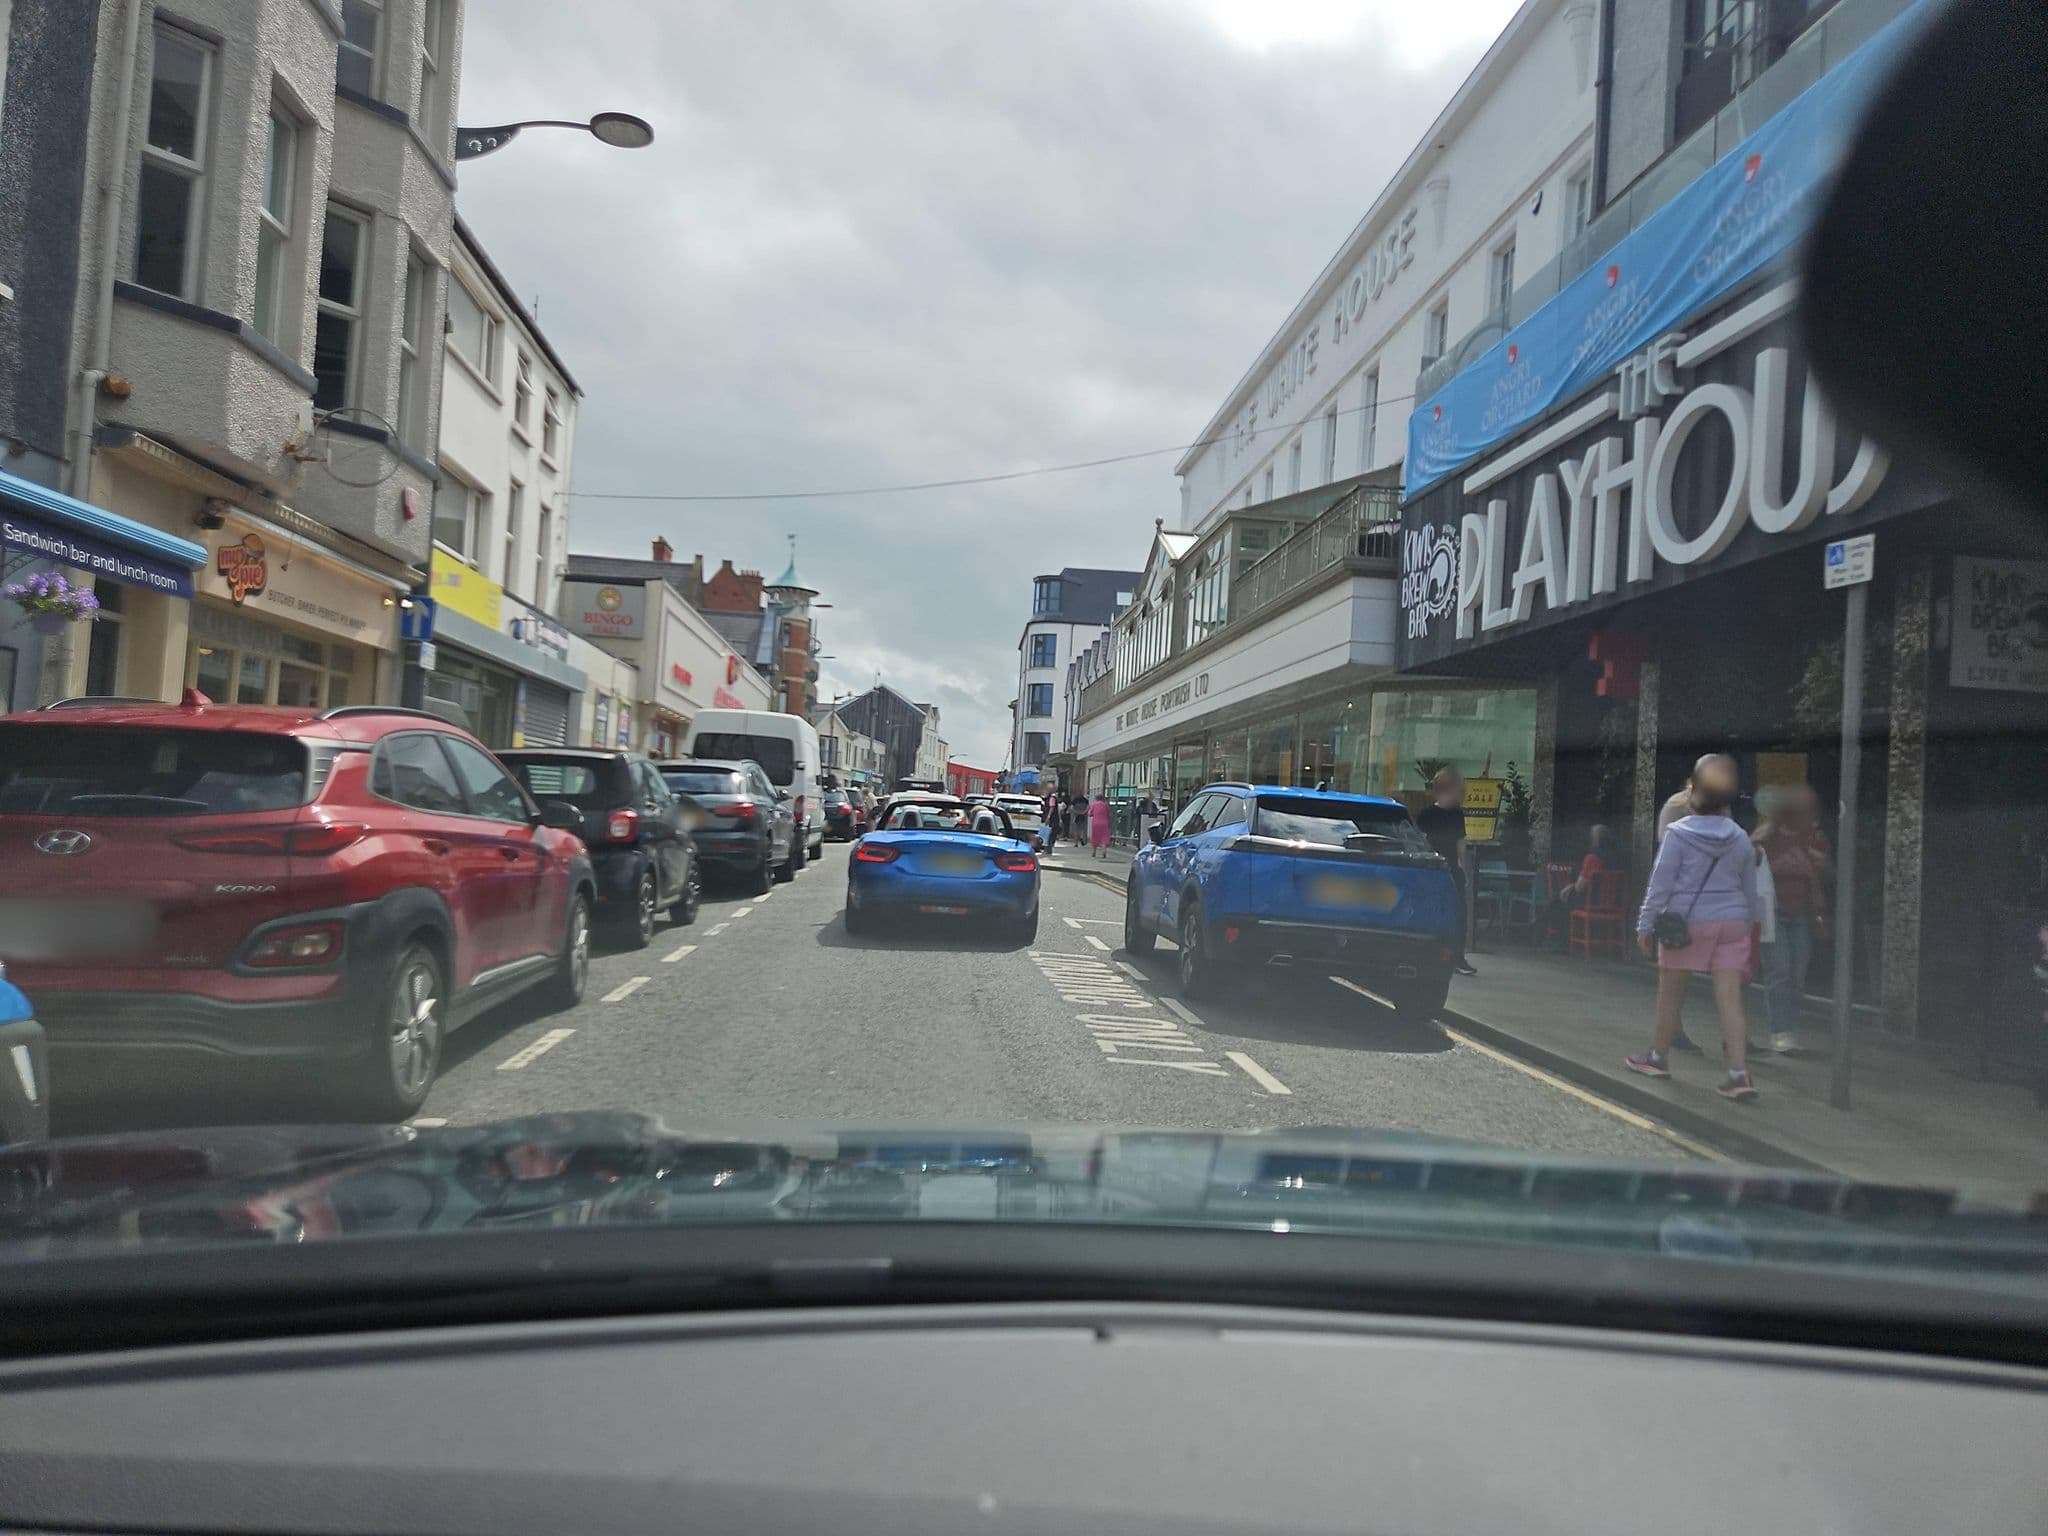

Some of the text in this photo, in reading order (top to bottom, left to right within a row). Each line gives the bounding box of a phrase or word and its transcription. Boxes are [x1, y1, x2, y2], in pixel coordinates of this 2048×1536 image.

[1333, 207, 1418, 344] HOUSE
[1616, 333, 1688, 421] THE
[3, 523, 178, 591] Sandwich bar and lunch room
[1401, 571, 1430, 609] BREW
[584, 612, 635, 626] BINGO
[1408, 600, 1430, 640] BAR
[1194, 672, 1209, 698] LTD
[215, 884, 277, 894] KONA
[1027, 950, 1154, 1008] LOADING
[1075, 1013, 1232, 1077] ONLY
